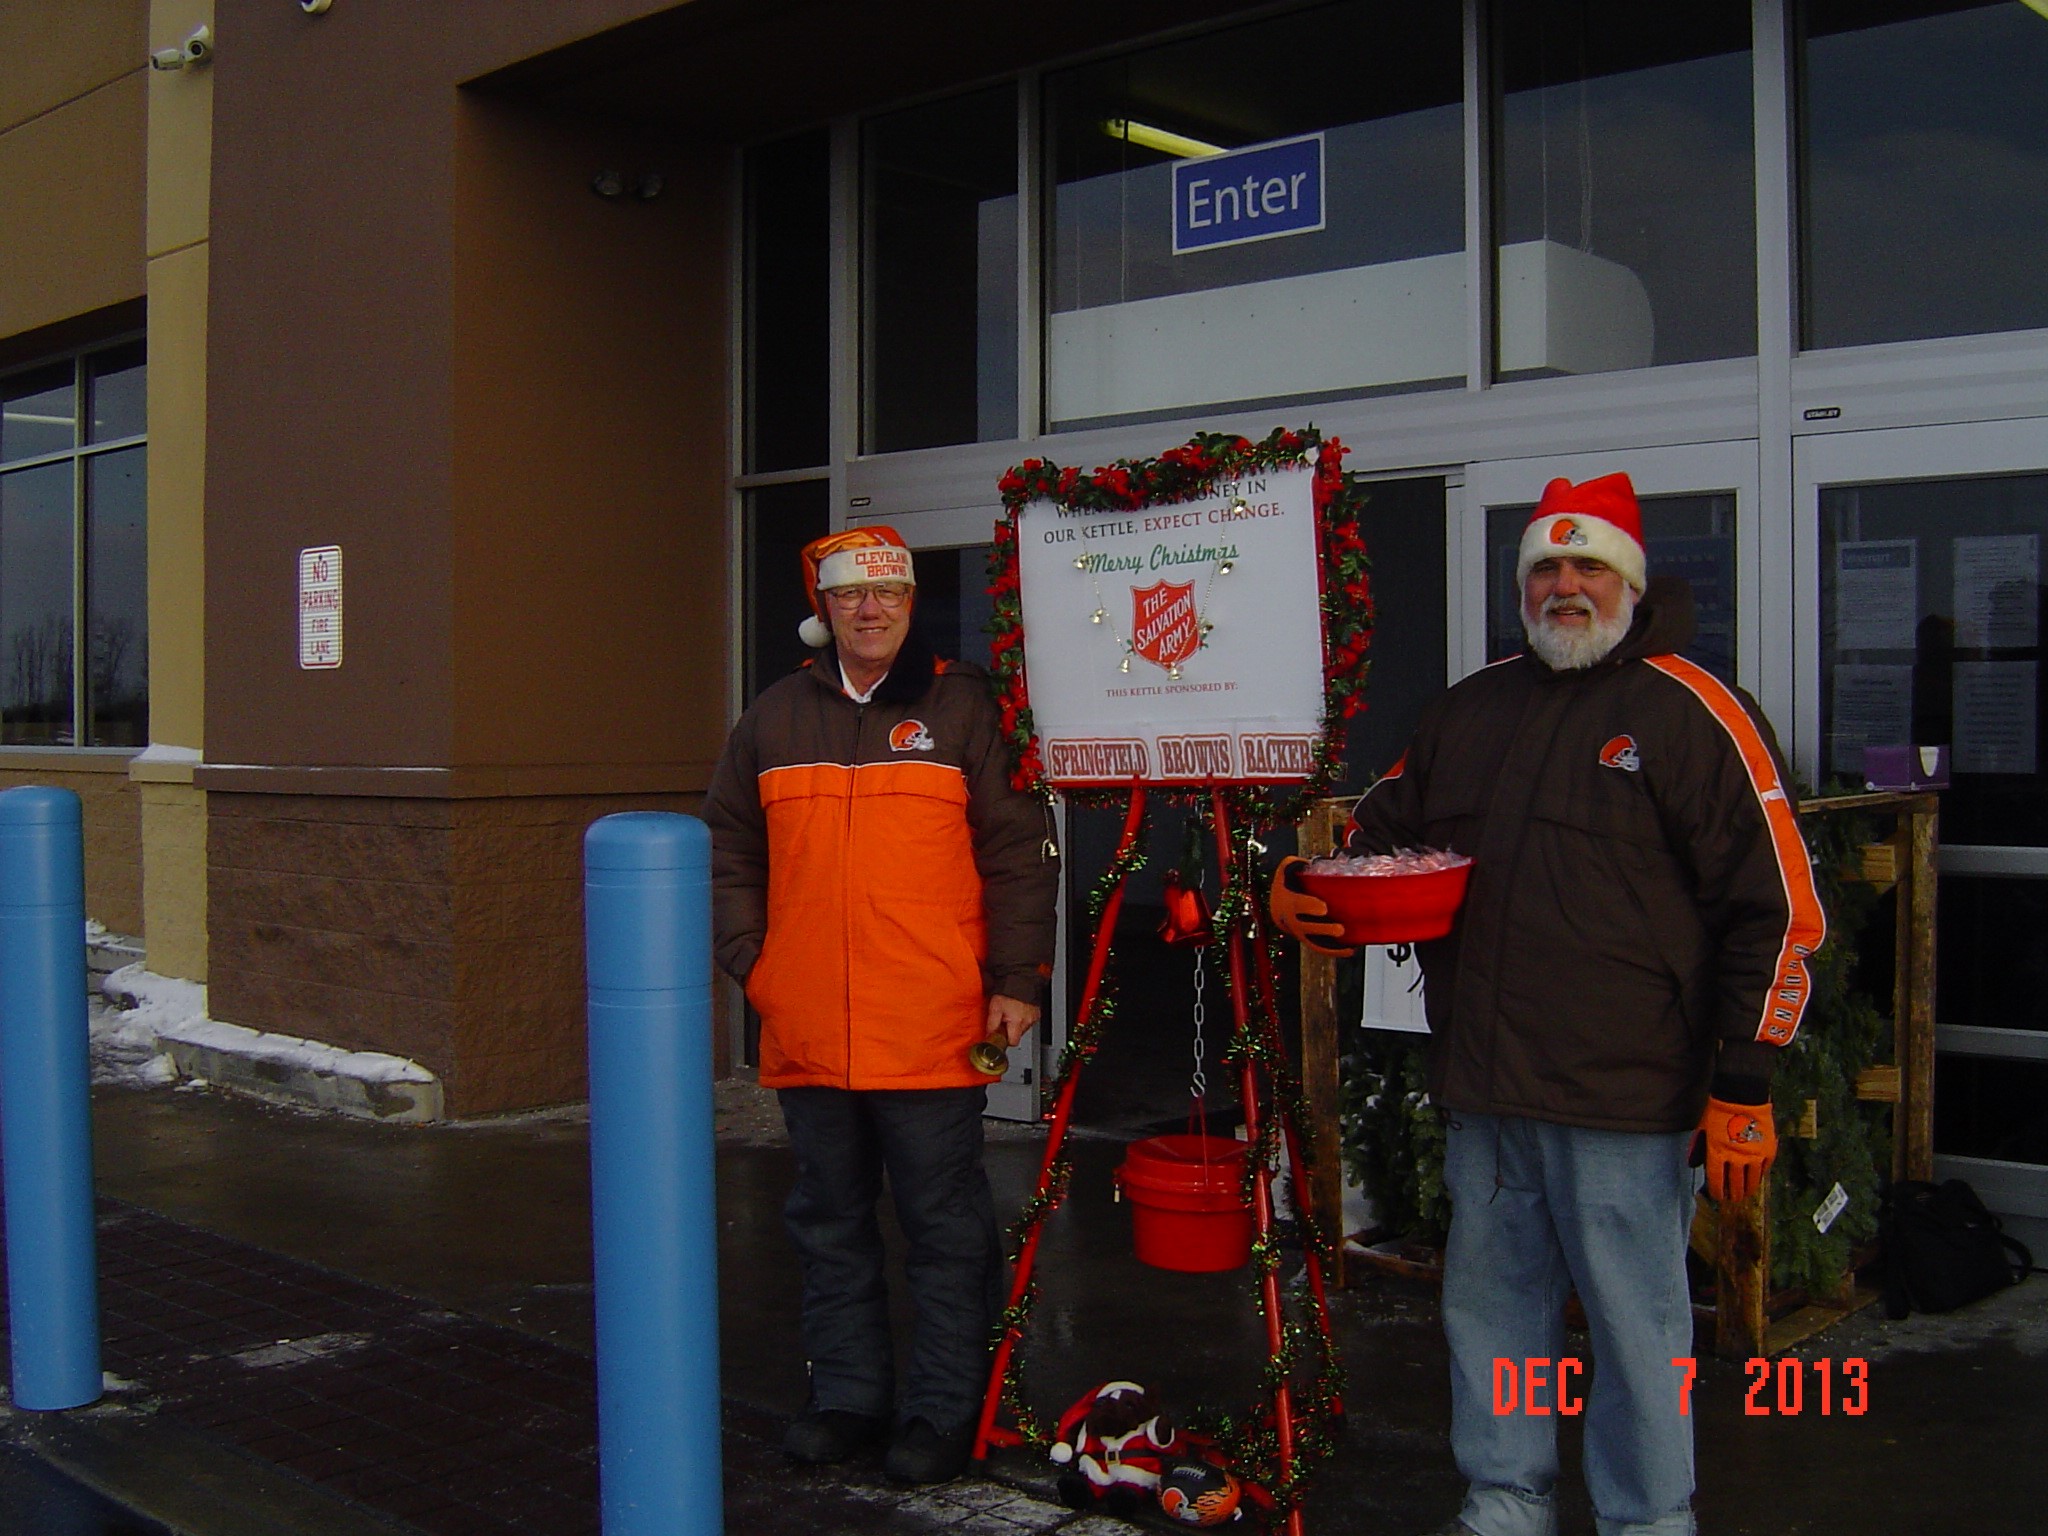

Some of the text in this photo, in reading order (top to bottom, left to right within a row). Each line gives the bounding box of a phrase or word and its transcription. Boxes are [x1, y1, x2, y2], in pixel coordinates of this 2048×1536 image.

[1189, 172, 1307, 229] Enter
[1247, 479, 1267, 494] IN
[1044, 502, 1285, 545] OUR KETTLE, EXPECT CHANGE.
[312, 560, 329, 583] NO
[867, 564, 907, 578] BROWNS
[1088, 543, 1240, 575] Merry Christmas
[302, 589, 339, 609] PARKING
[1143, 587, 1168, 618] THE
[312, 618, 329, 633] FIRE
[1136, 590, 1192, 650] SALVATION
[310, 640, 330, 655] LANE
[1158, 617, 1191, 661] ARMY
[1105, 681, 1239, 698] THIS KETTLE SPONSORED BY:
[1051, 742, 1148, 777] SPRINGFIELD
[1160, 738, 1230, 776] BROWNS
